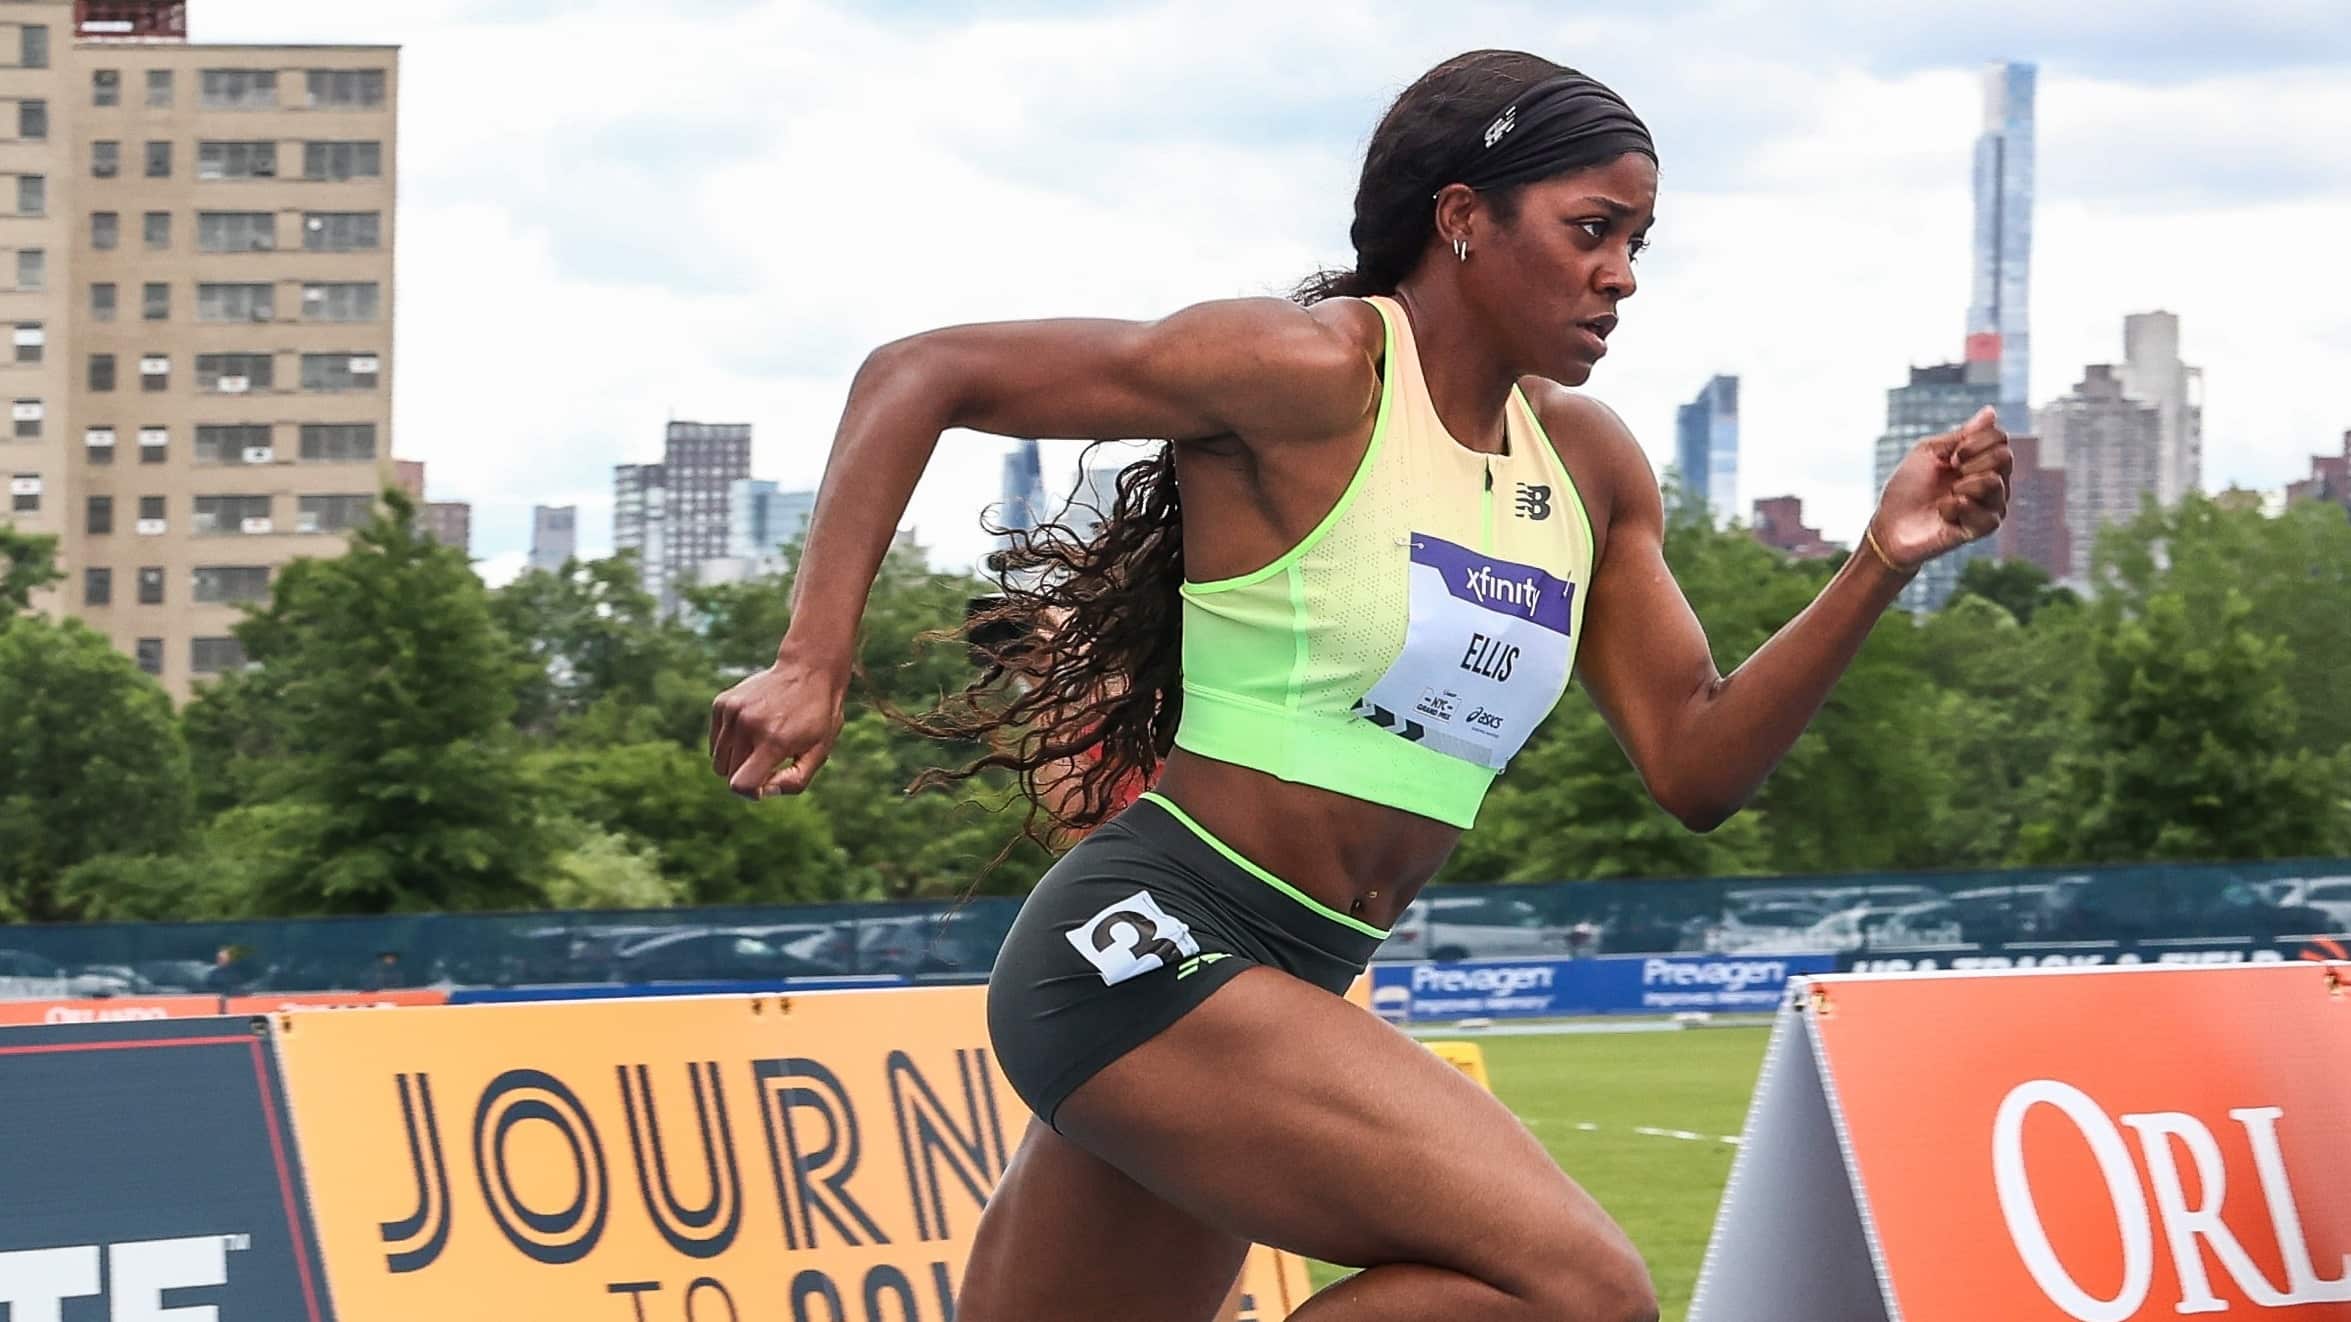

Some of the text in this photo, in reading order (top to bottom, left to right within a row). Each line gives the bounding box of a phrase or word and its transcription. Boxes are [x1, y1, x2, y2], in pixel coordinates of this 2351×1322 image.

[1466, 566, 1540, 616] xfinity
[1460, 632, 1520, 682] ELLIS
[1091, 910, 1185, 966] 3
[1412, 965, 1555, 997] Prevagen
[1642, 958, 1786, 991] Prevagen
